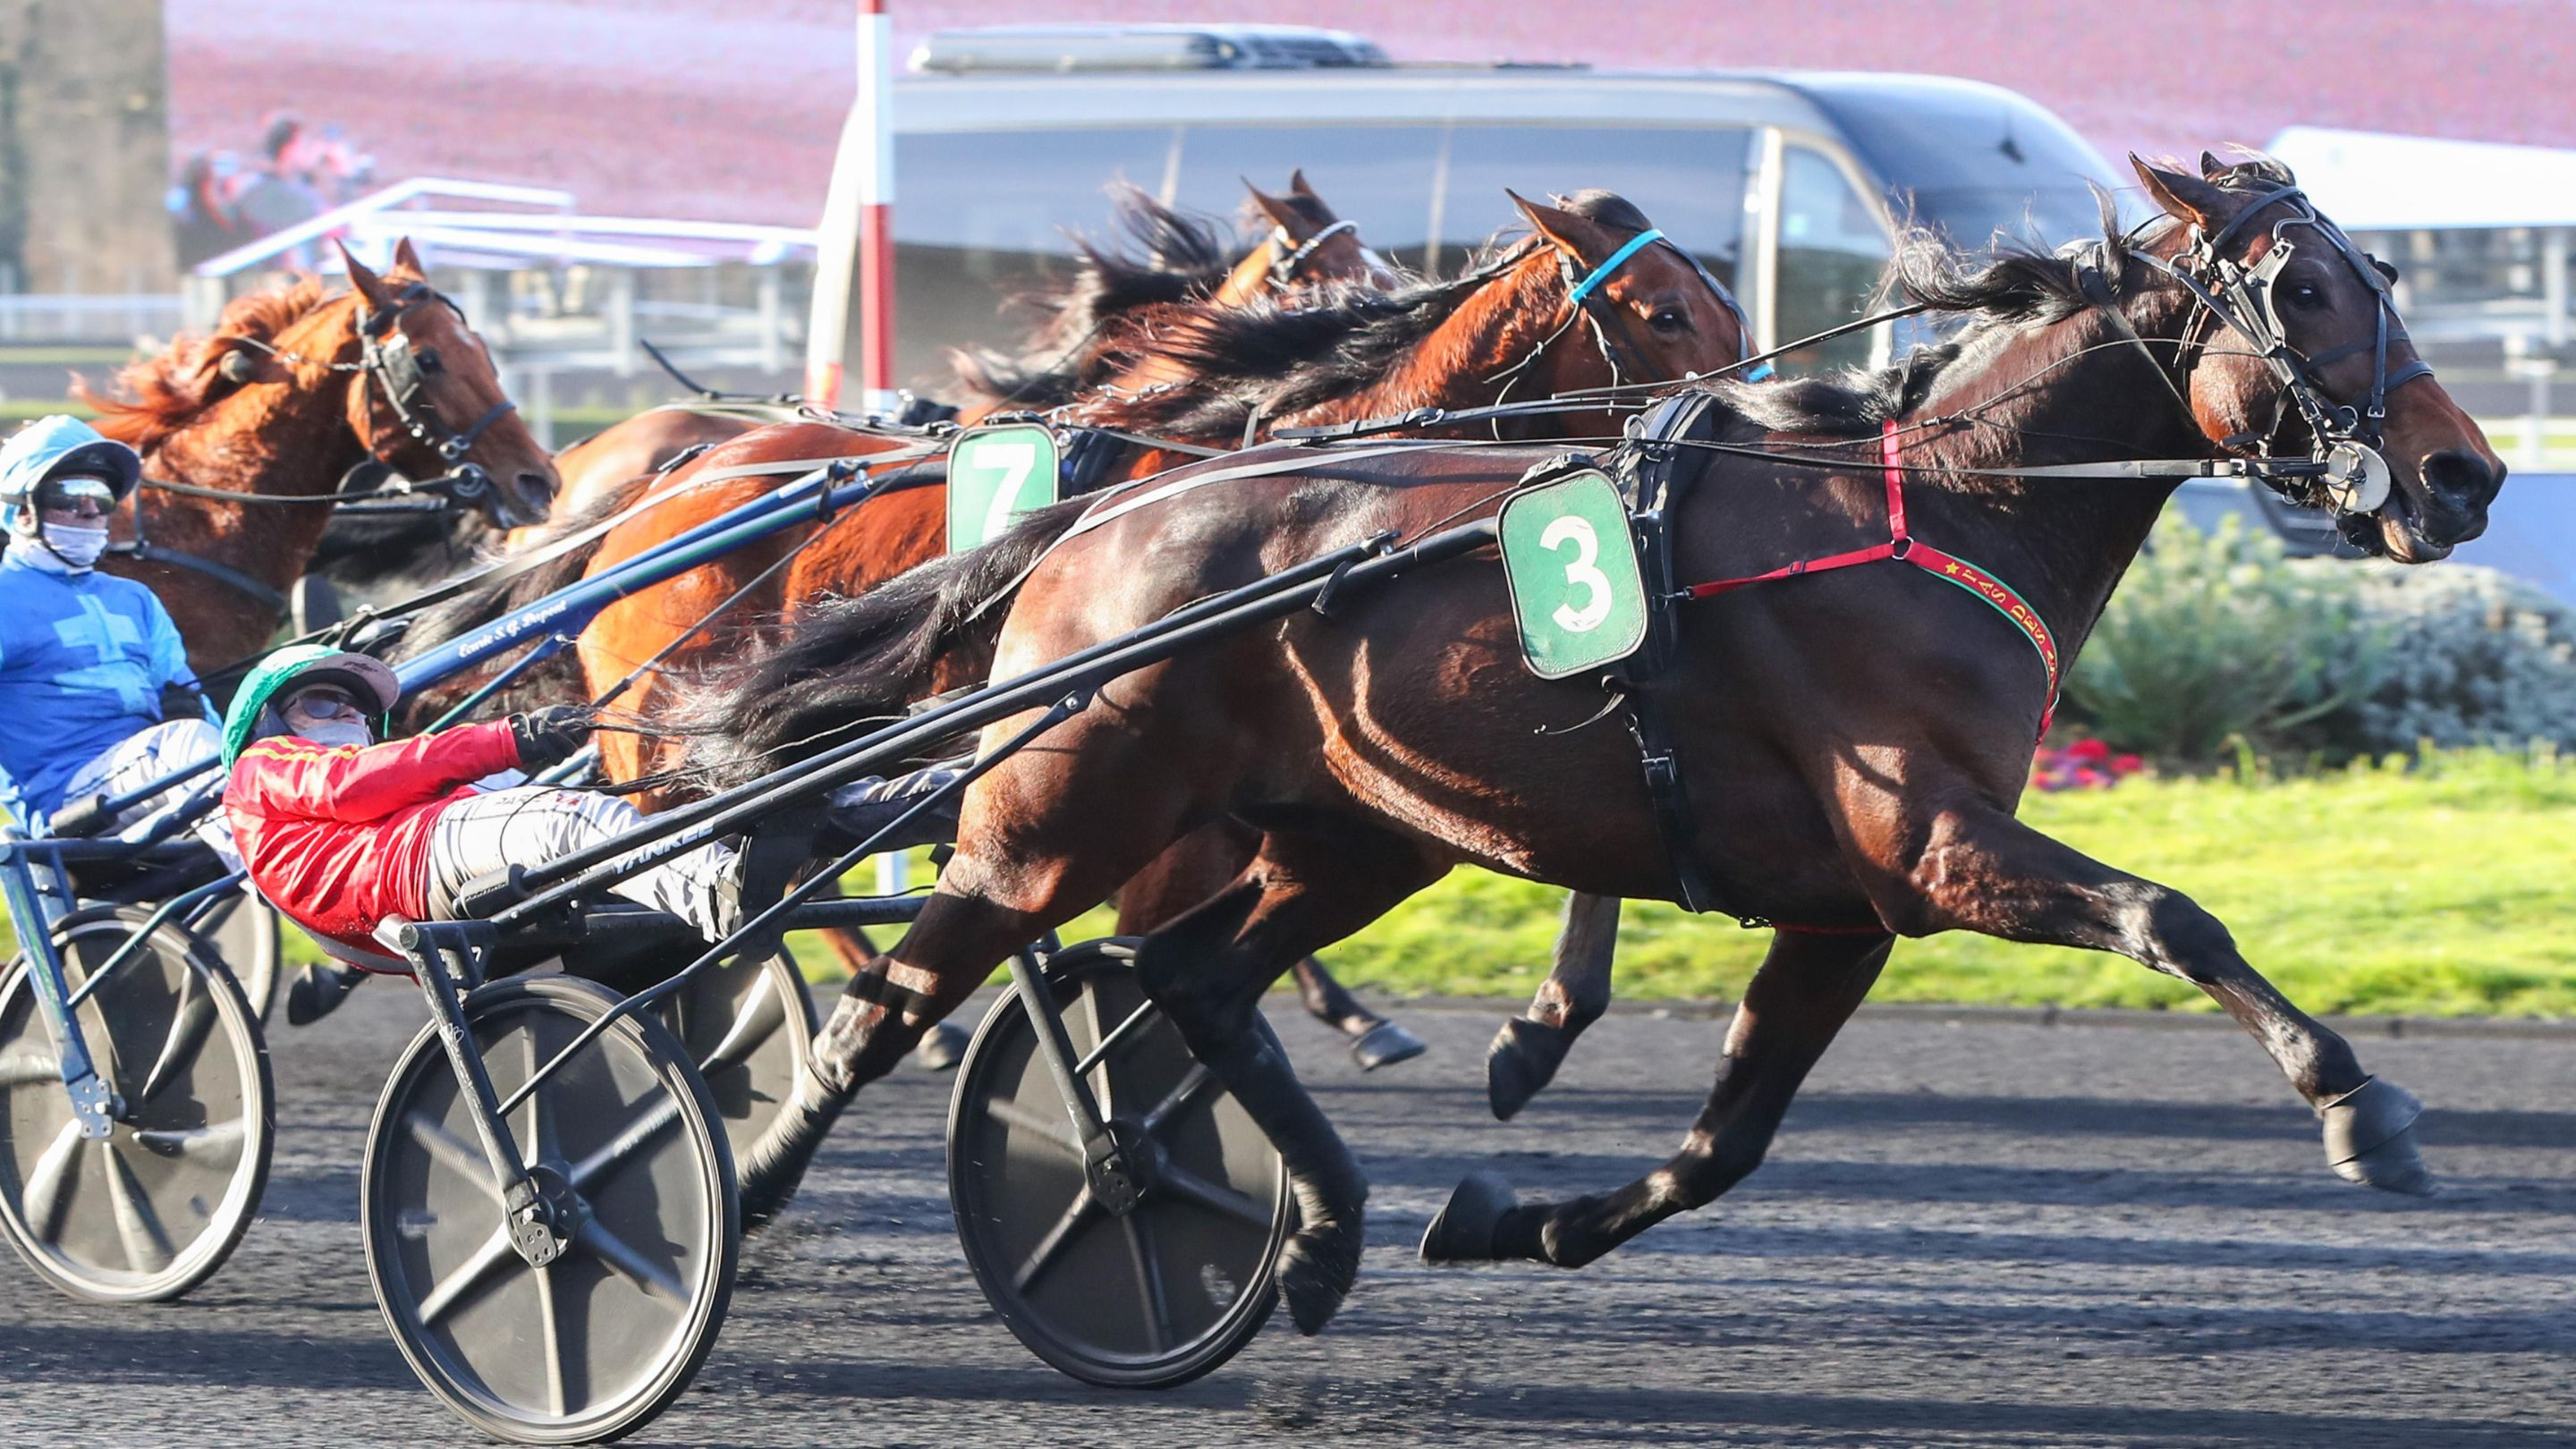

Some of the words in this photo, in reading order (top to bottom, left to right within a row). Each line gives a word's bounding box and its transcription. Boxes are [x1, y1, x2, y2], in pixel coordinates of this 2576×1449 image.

[973, 443, 1036, 547] 7
[1539, 514, 1613, 632] 3
[2011, 605, 2046, 644] DES
[613, 819, 715, 875] YANKEE
